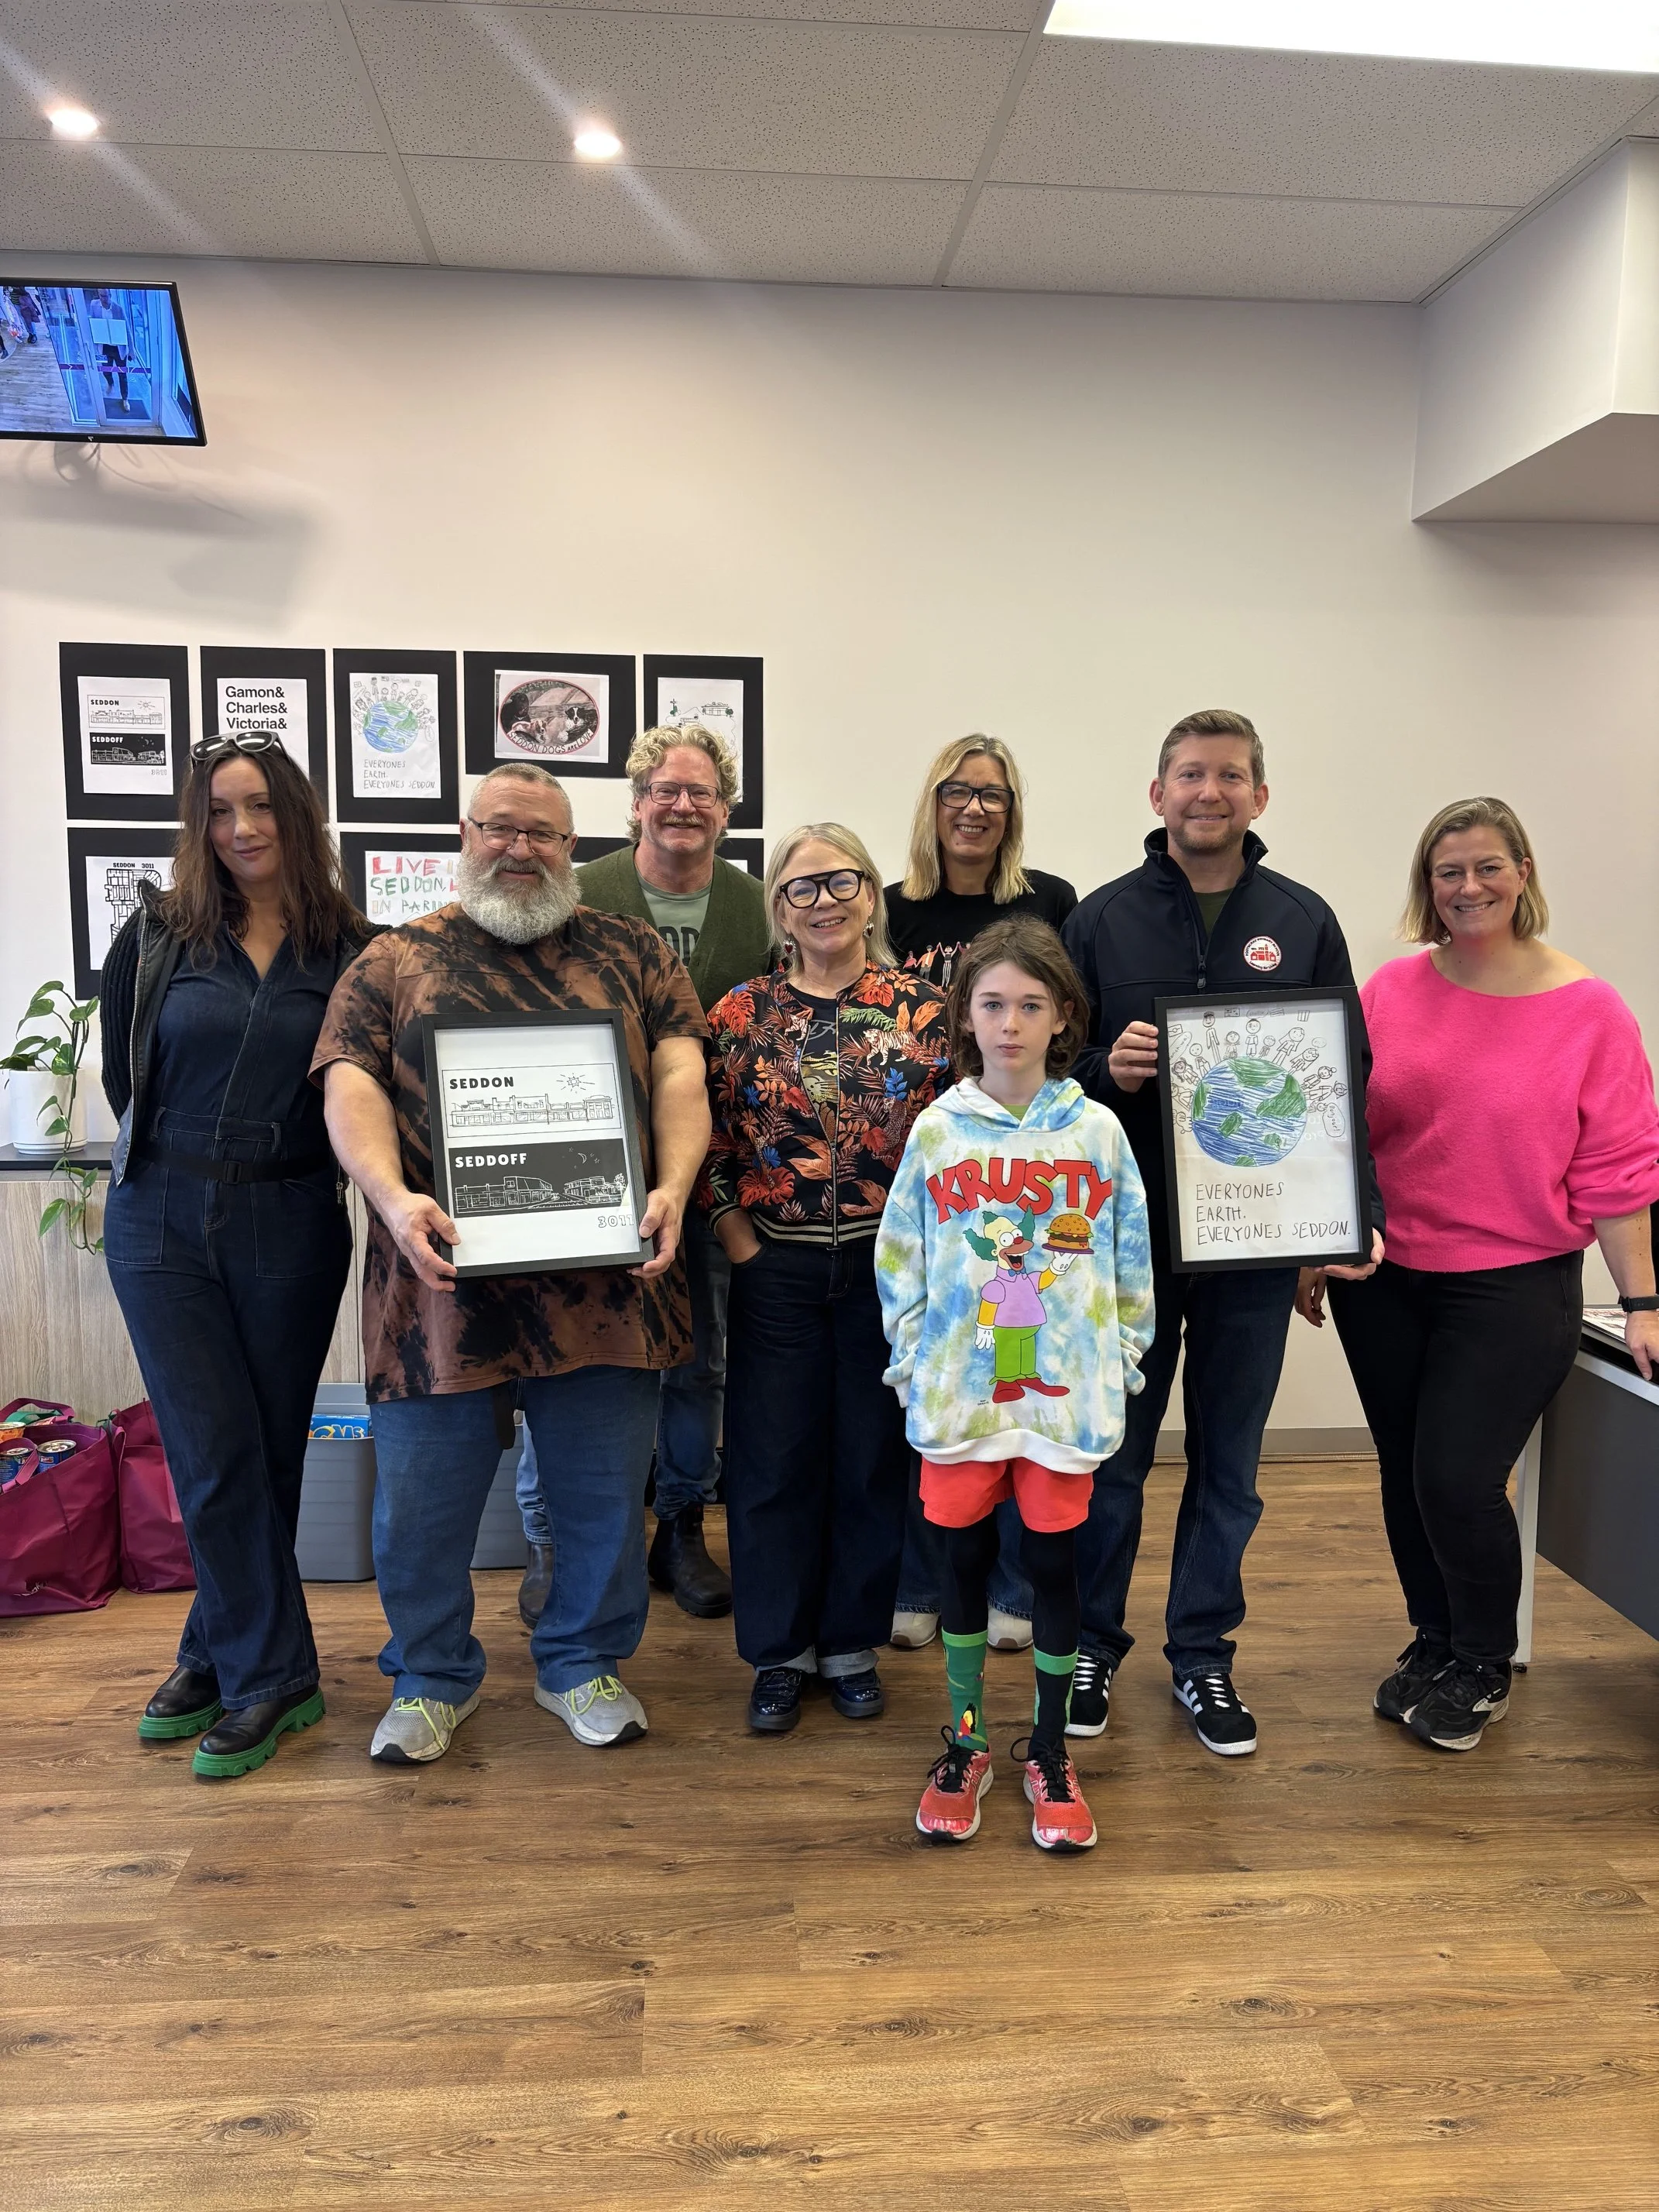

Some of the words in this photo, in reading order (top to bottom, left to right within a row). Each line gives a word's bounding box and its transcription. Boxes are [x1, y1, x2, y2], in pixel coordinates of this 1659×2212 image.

[225, 685, 285, 698] Gamon&
[226, 702, 287, 713] Charles&
[226, 717, 287, 729] Victoria&
[507, 731, 540, 753] SEDDON
[542, 745, 565, 754] DOGS
[576, 730, 594, 747] LOVE
[364, 759, 406, 768] EVERYONES
[364, 779, 404, 789] EVERYONES
[373, 856, 441, 876] LIVE
[447, 859, 453, 874] I
[372, 900, 391, 914] IN
[449, 1077, 514, 1089] SEDDON
[455, 1153, 527, 1168] SEDDOFF
[926, 1158, 1112, 1224] KRUSTY
[1196, 1182, 1284, 1200] EVERYONES
[598, 1214, 634, 1228] 3011
[1197, 1206, 1245, 1222] EARTH.
[1197, 1223, 1283, 1245] EVERYONES
[1292, 1221, 1351, 1238] SEDDON.
